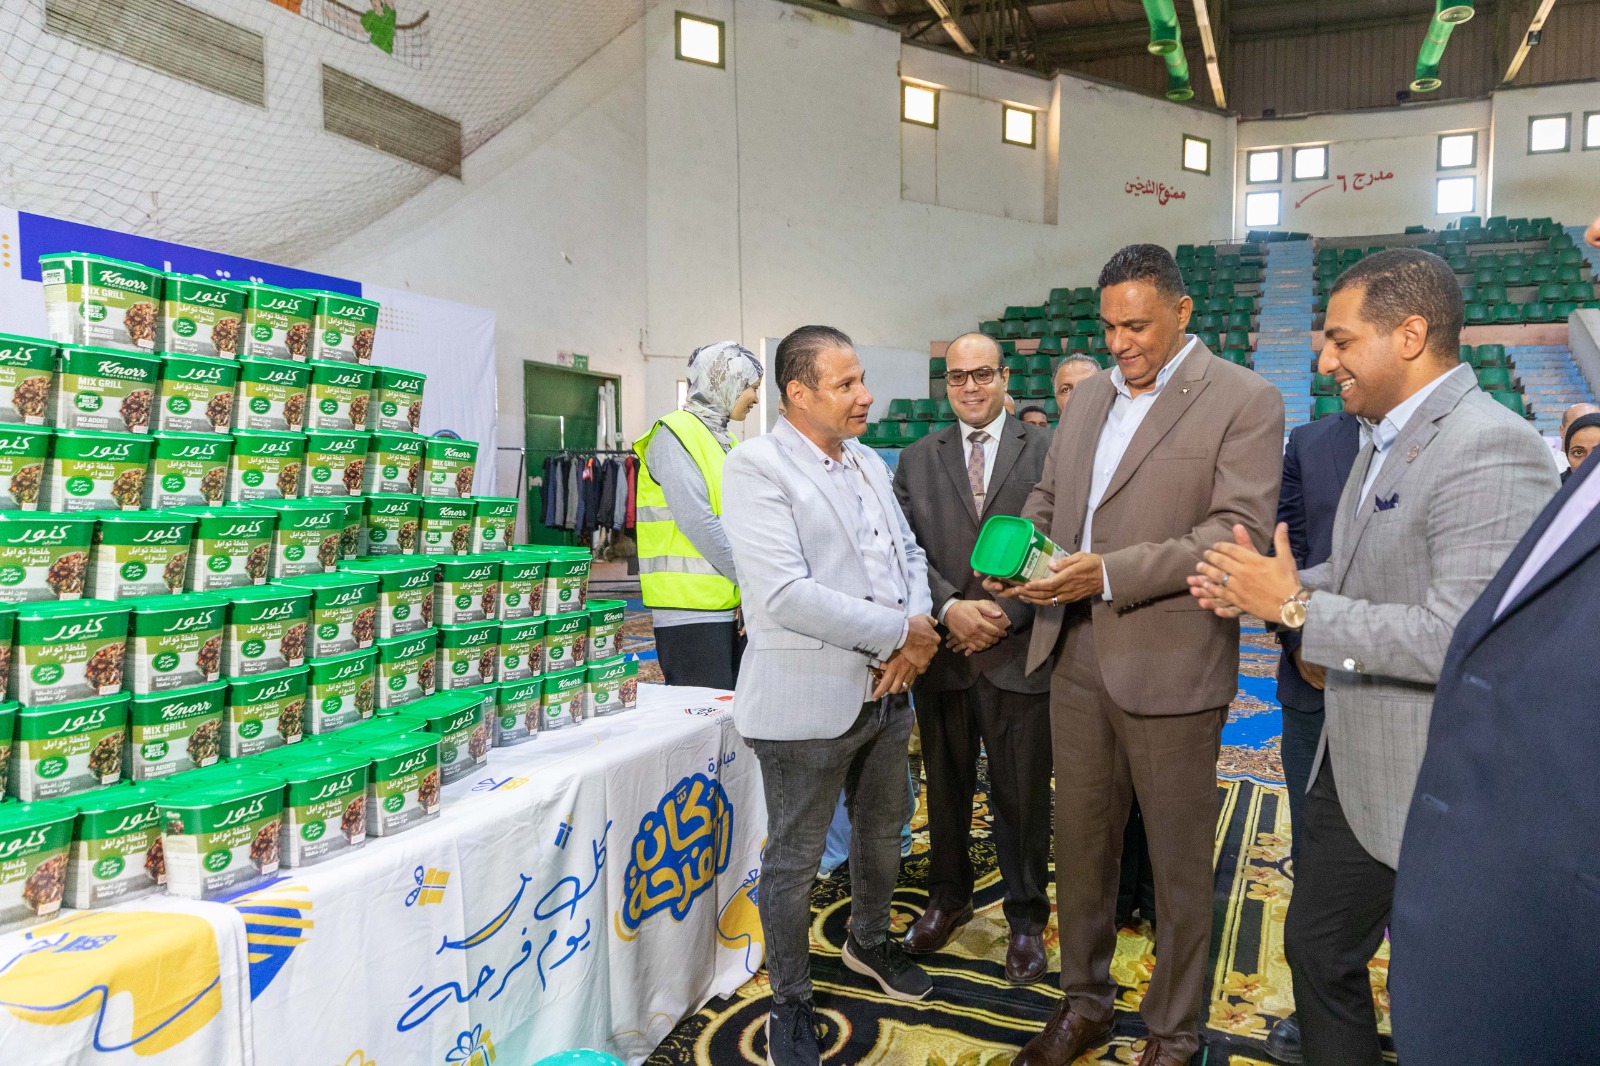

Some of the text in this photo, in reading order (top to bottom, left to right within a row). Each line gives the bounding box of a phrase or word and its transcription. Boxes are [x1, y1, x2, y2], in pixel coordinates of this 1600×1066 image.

[1353, 170, 1393, 190] مدرج
[1159, 183, 1186, 205] ممنوع
[99, 271, 148, 291] Knorr
[102, 287, 124, 300] GRILL
[183, 291, 230, 303] كنور
[261, 299, 302, 310] كنور
[332, 306, 368, 317] كنور
[0, 347, 37, 361] كنو
[98, 361, 147, 378] Knorr
[177, 368, 224, 380] كنور
[260, 370, 299, 382] كنور
[78, 377, 96, 386] MIX
[99, 378, 122, 388] GRILL
[329, 374, 364, 384] كنور
[389, 380, 420, 389] كنور
[0, 436, 34, 449] كنو
[252, 441, 293, 453] كنور
[321, 439, 358, 450] كنور
[391, 442, 421, 450] كنور
[79, 444, 134, 458] كنور
[172, 444, 218, 457] كنور
[444, 448, 471, 458] Knorr
[378, 502, 410, 513] كنور
[440, 507, 466, 517] Knorr
[490, 504, 514, 514] كنور
[294, 513, 333, 527] كنور
[7, 525, 72, 542] كنور
[134, 526, 186, 542] كنور
[219, 521, 264, 536] كنور
[463, 565, 492, 579] كنور
[513, 566, 540, 578] كنور
[566, 562, 588, 574] كنور
[400, 571, 431, 587] كنور
[325, 587, 365, 606] كنور
[251, 601, 296, 620] كنور
[164, 610, 215, 632] كنور
[556, 619, 580, 632] كنور
[43, 617, 107, 641] كنور
[511, 626, 538, 640] كنور
[460, 630, 489, 645] كنور
[394, 639, 427, 658] كنور
[329, 659, 367, 679] كنور
[599, 664, 626, 679] كنور
[248, 679, 292, 701] كنور
[558, 678, 580, 688] Knorr
[508, 685, 535, 700] كنور
[161, 701, 211, 718] Knorr
[48, 707, 110, 734] كنور
[444, 708, 476, 733] كنور
[143, 721, 187, 735] MIX GRILL
[389, 750, 428, 776] كنور
[310, 773, 355, 801] كنور
[213, 796, 267, 828] كنور
[537, 918, 590, 992] يوم
